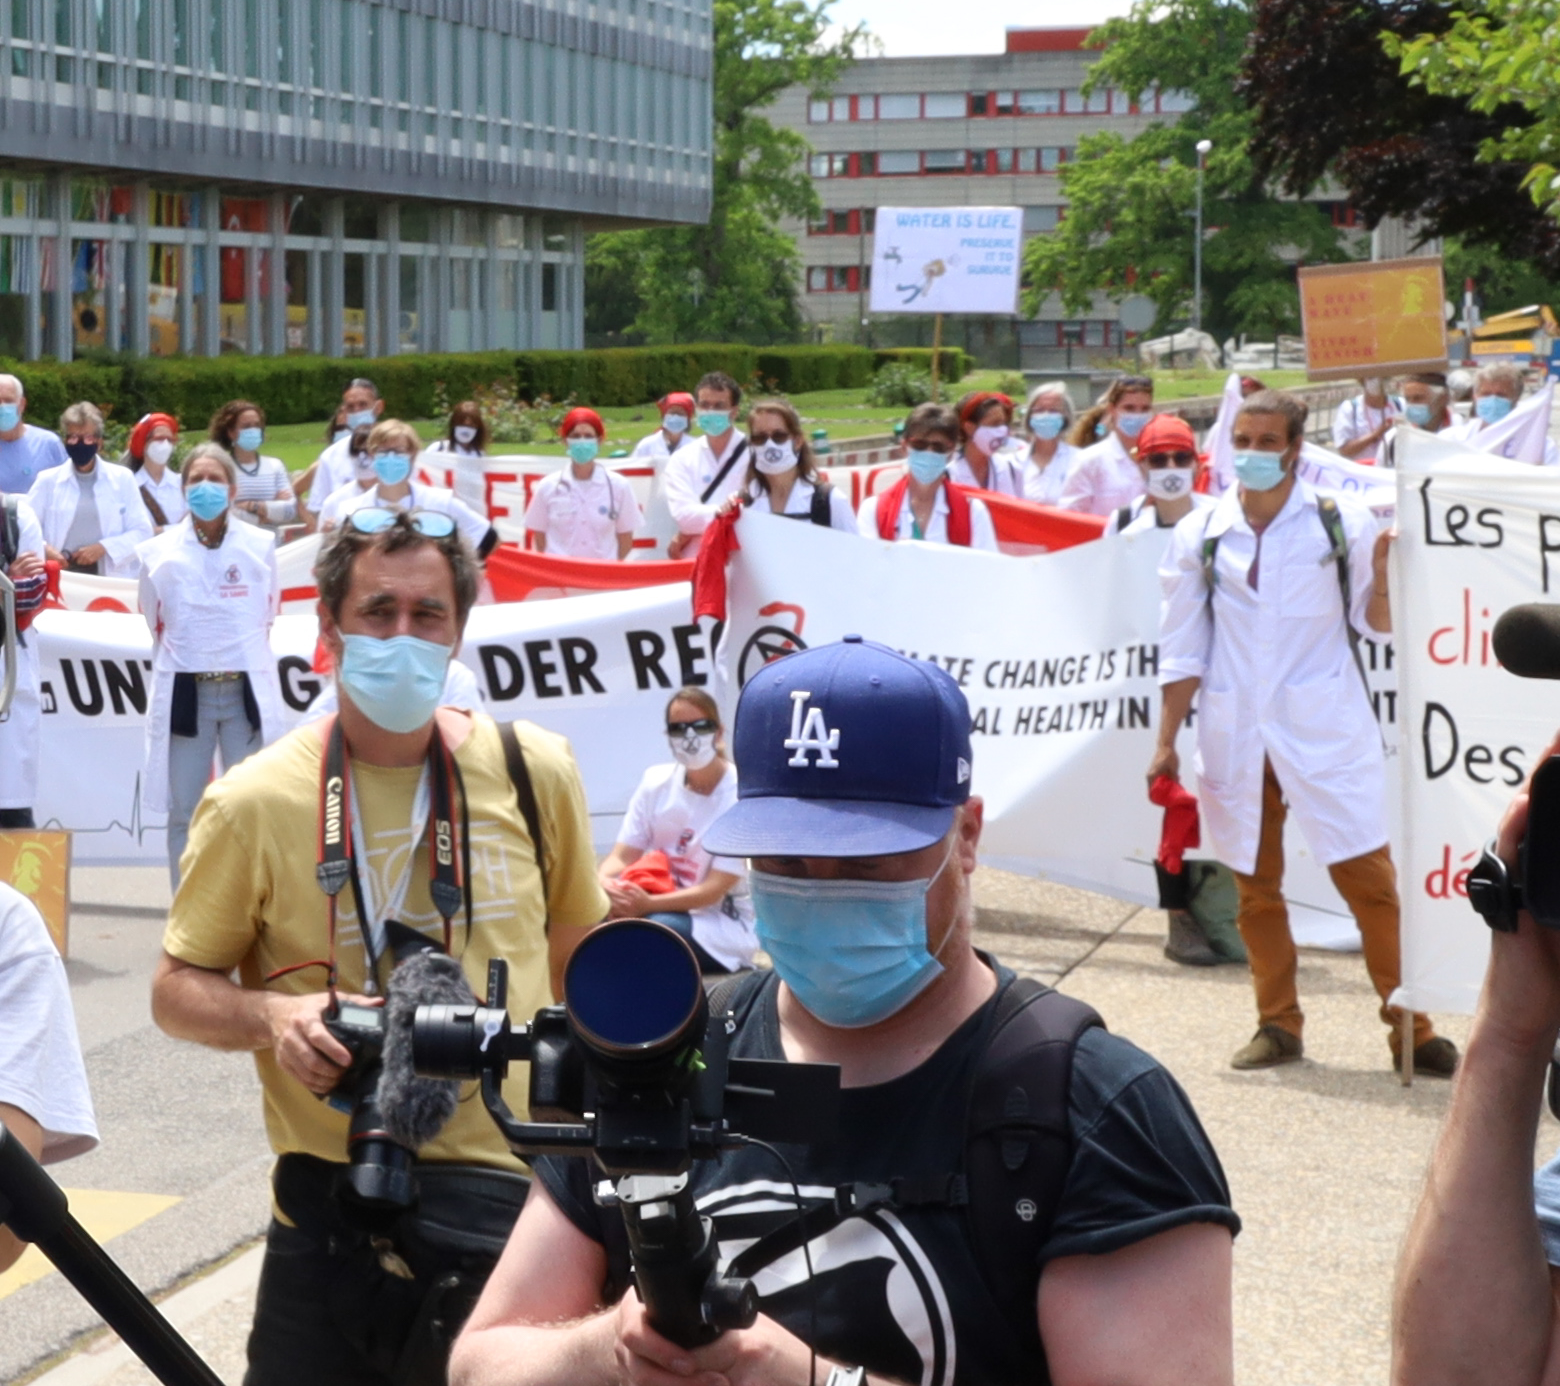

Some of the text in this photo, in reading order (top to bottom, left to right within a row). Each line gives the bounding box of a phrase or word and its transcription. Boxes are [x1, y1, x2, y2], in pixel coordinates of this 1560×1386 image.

[896, 214, 951, 228] WATER
[957, 215, 972, 228] IS
[1420, 477, 1505, 549] Les
[477, 635, 608, 702] DER
[984, 653, 1090, 689] CHANGE
[1096, 649, 1117, 681] IS
[1126, 644, 1159, 678] TH
[784, 690, 841, 769] LA
[1013, 698, 1109, 736] HEALTH
[1116, 695, 1151, 730] IN
[1421, 701, 1526, 787] Des
[324, 776, 344, 846] Canon
[434, 819, 453, 866] EOS
